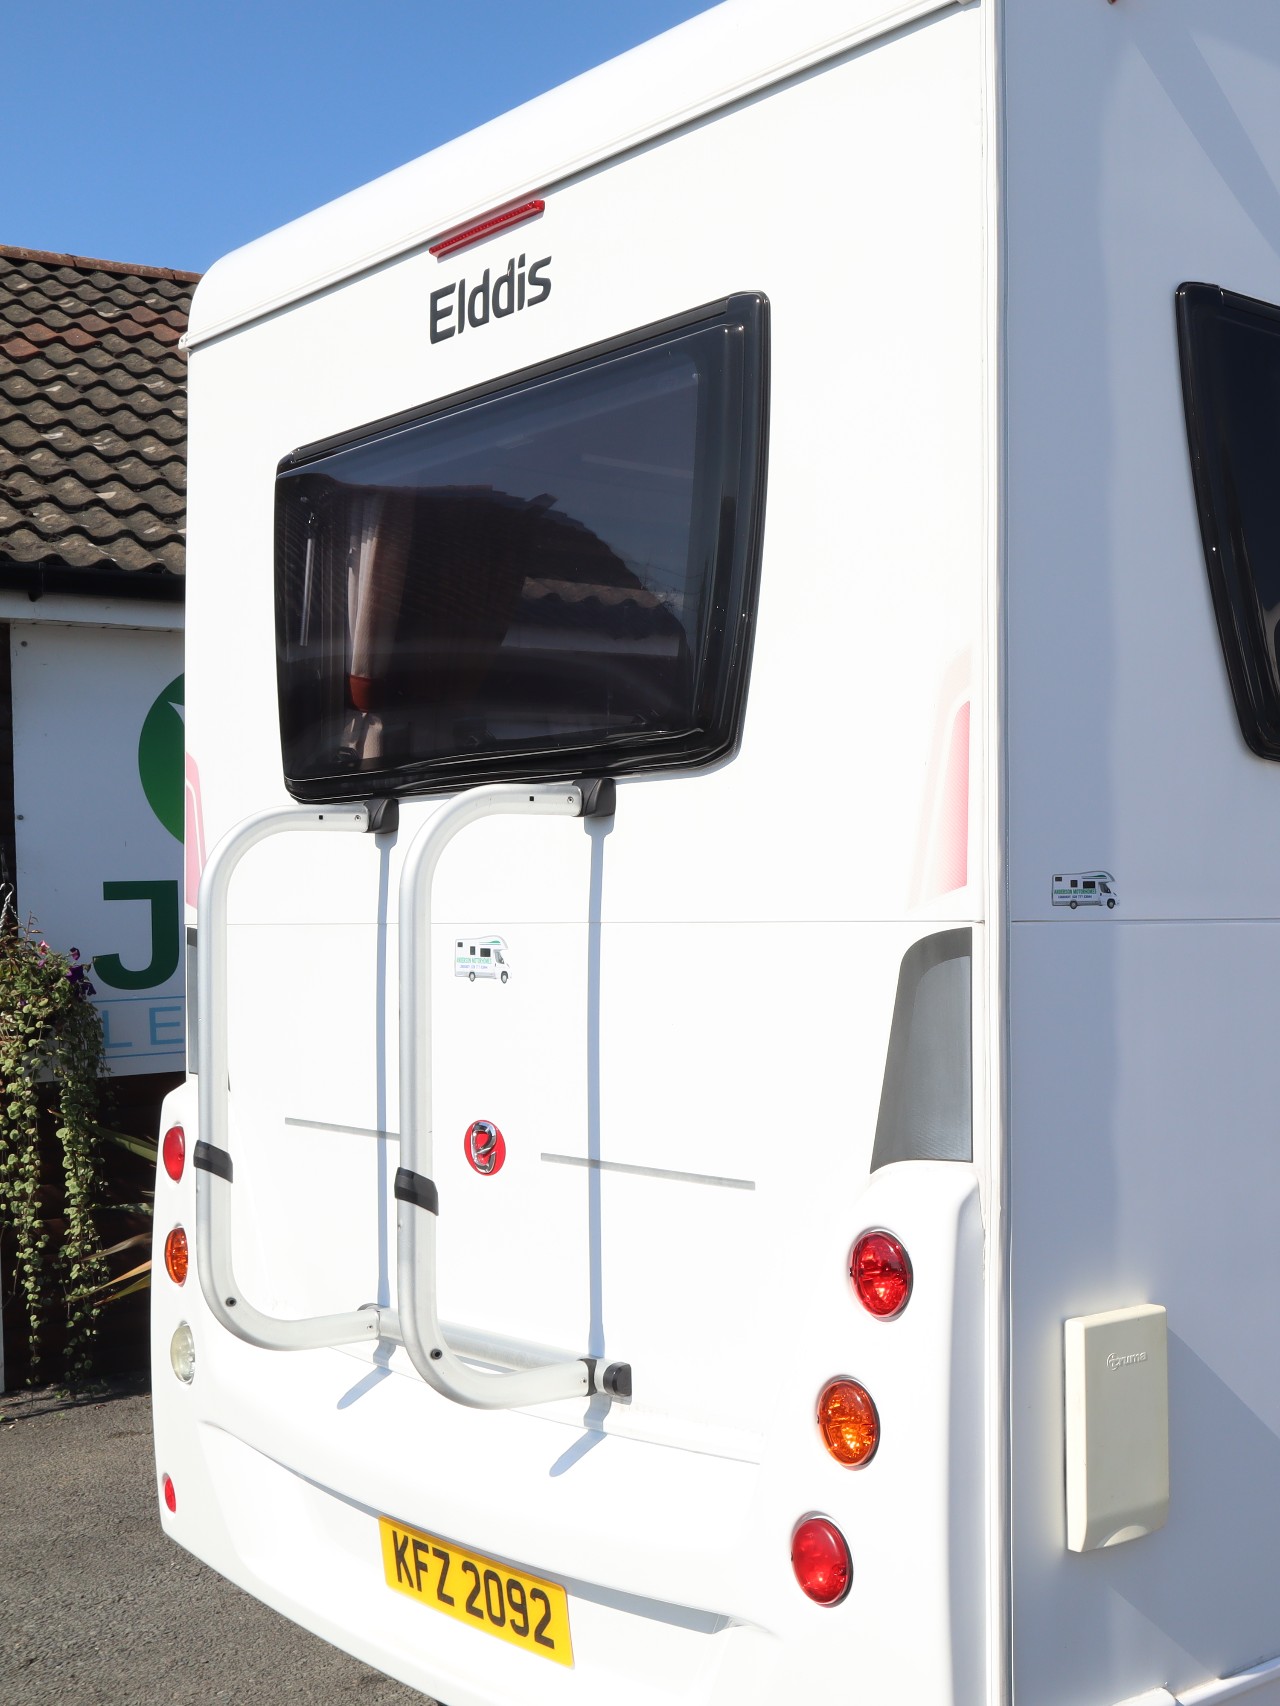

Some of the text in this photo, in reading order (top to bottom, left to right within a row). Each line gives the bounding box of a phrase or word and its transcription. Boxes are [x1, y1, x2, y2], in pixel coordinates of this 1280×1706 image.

[429, 252, 553, 345] Elddis
[391, 1529, 555, 1650] KFZ 2092
